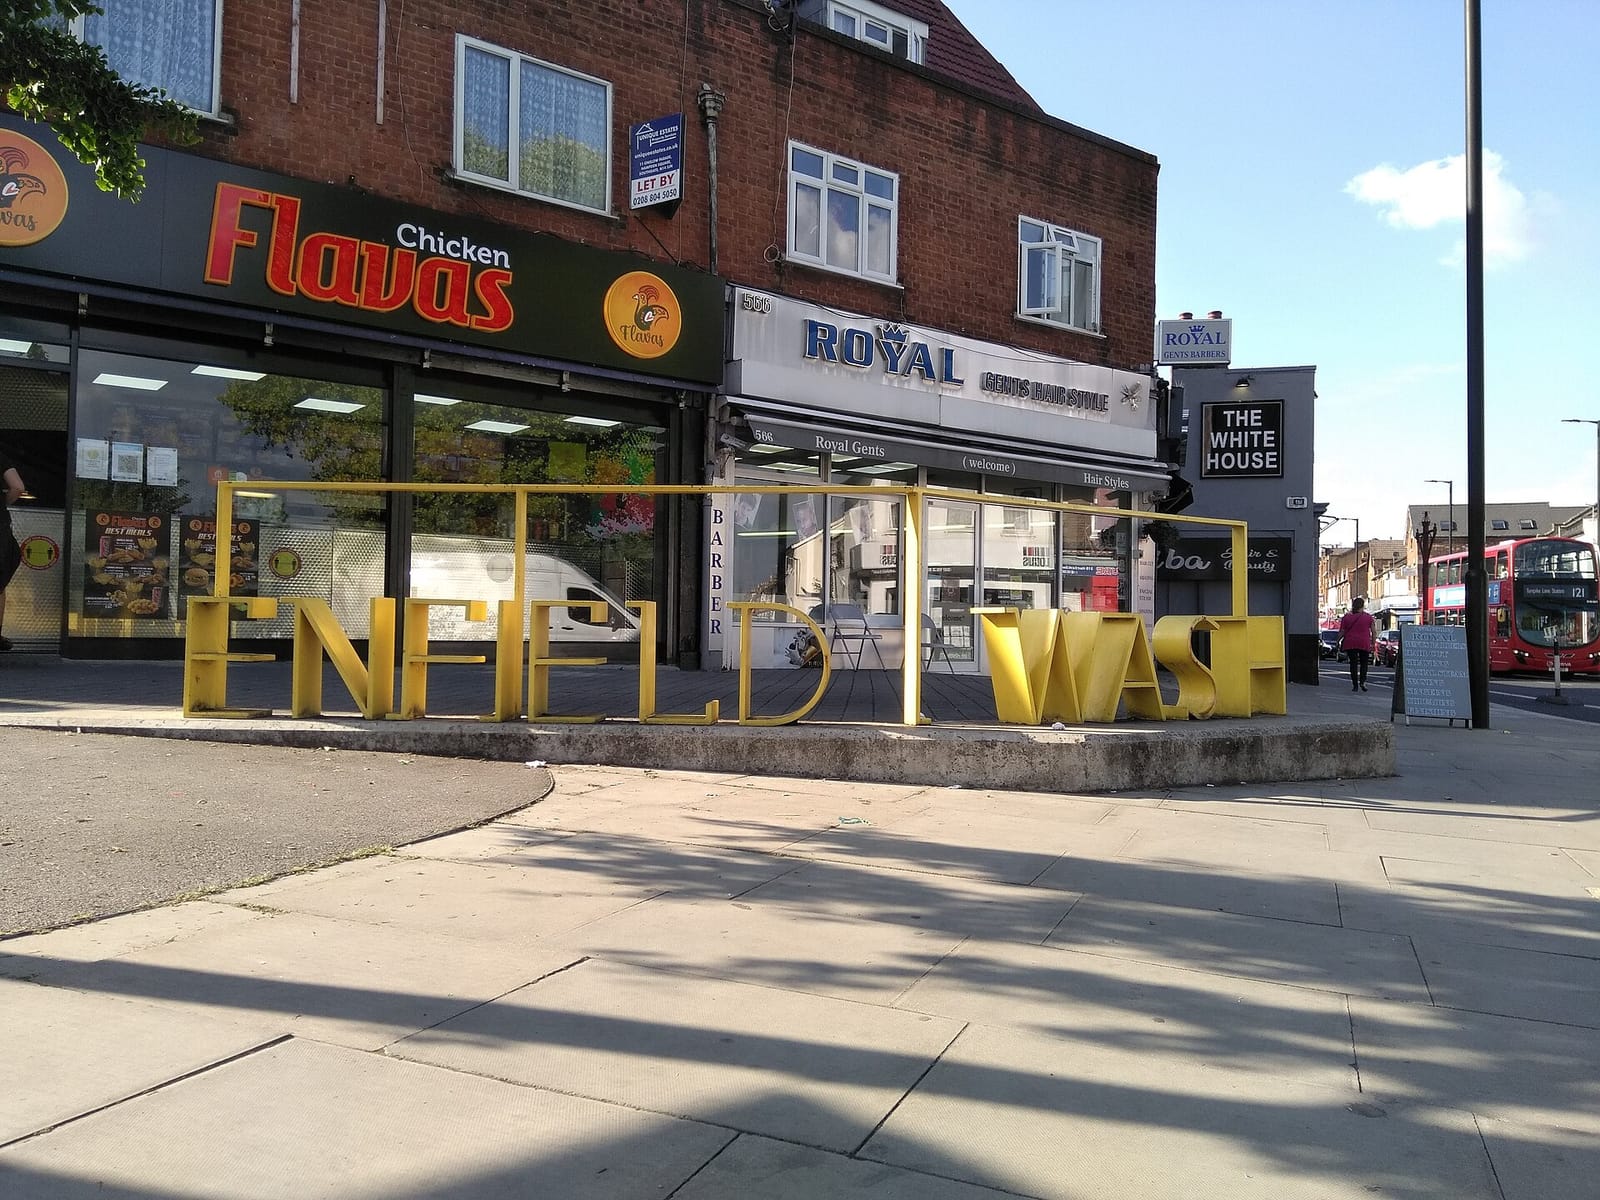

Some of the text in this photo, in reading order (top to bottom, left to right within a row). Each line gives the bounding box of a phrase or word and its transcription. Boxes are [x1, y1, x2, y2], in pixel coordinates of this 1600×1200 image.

[640, 125, 679, 140] UNIQUE ESTATES
[637, 173, 675, 192] LET BY
[633, 188, 677, 206] 0208 804 5050
[0, 211, 38, 231] vas
[396, 223, 511, 269] Chicken
[204, 181, 514, 333] Flavas
[743, 292, 772, 313] 566
[620, 325, 665, 348] Flavas
[1165, 331, 1226, 346] ROYAL
[804, 319, 965, 385] ROYAL
[1164, 350, 1226, 359] GENTS BARBERS
[981, 371, 1110, 412] GENTS HAIR STYLE
[1223, 409, 1262, 427] THE
[755, 429, 774, 442] 566
[1210, 430, 1275, 449] WHITE
[815, 435, 885, 457] Royal Gents
[1207, 451, 1278, 470] HOUSE
[1083, 472, 1130, 490] Hair Styles
[104, 527, 153, 537] BEST MEALS
[1265, 549, 1278, 558] &
[711, 509, 724, 634] BARBER
[1572, 588, 1585, 597] 121
[1412, 632, 1457, 641] ROYAL
[183, 596, 1287, 727] ENFIELD WASH
